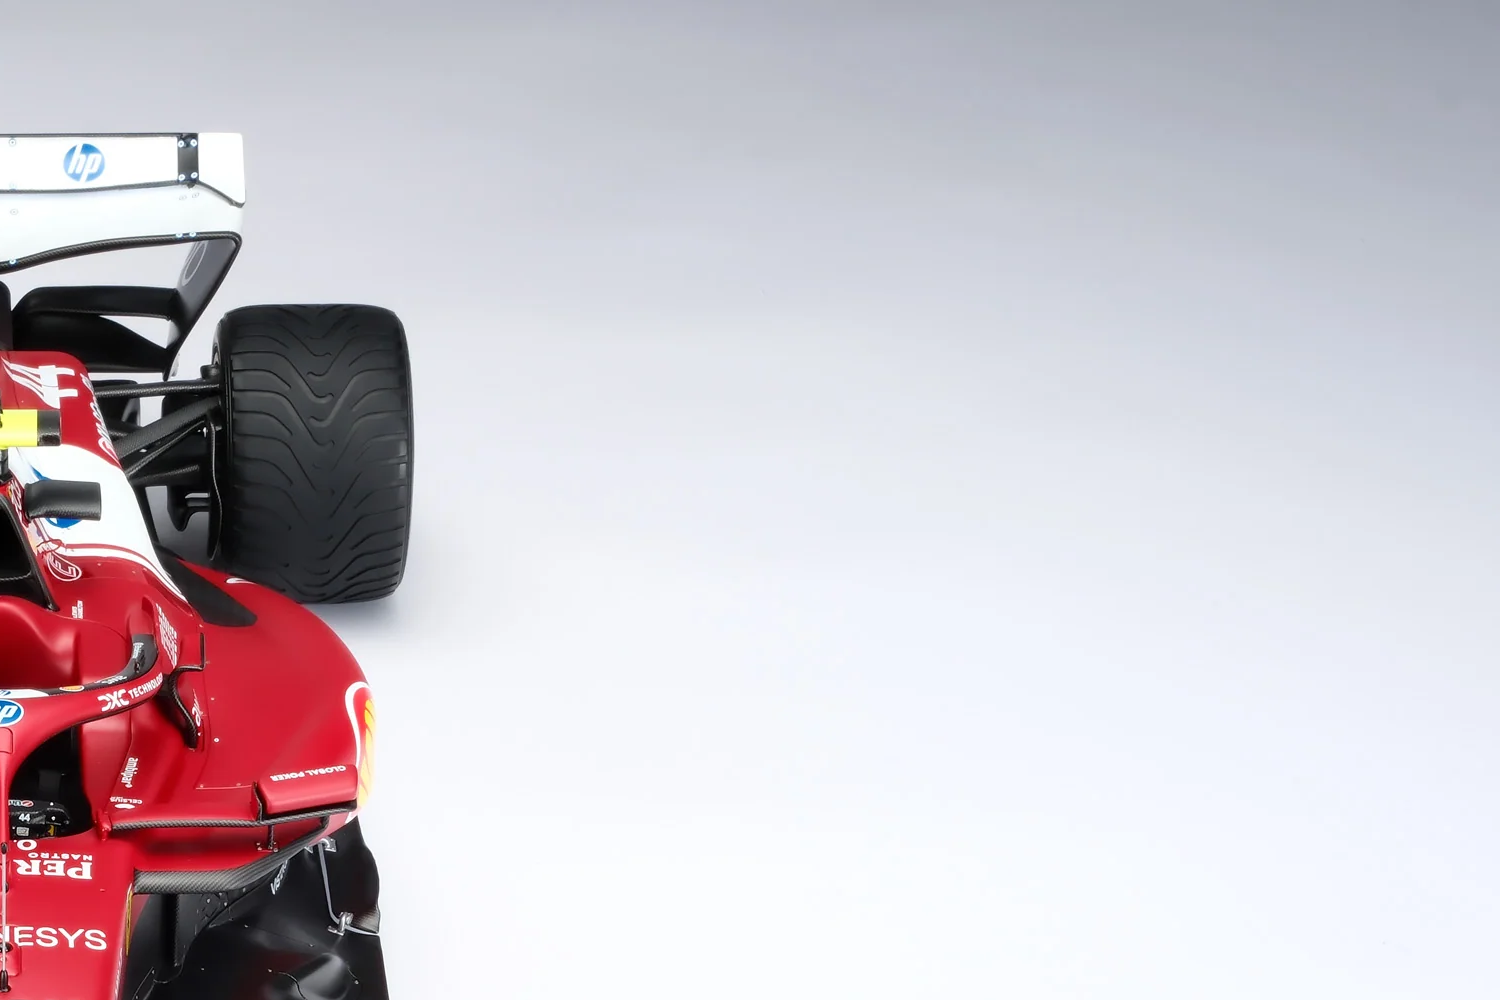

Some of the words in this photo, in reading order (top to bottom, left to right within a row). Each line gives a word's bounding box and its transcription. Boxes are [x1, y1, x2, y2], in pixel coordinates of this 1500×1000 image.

[66, 143, 104, 182] hp
[270, 770, 304, 782] POKER
[305, 764, 346, 778] GLOBAL
[28, 851, 93, 861] NASTRO
